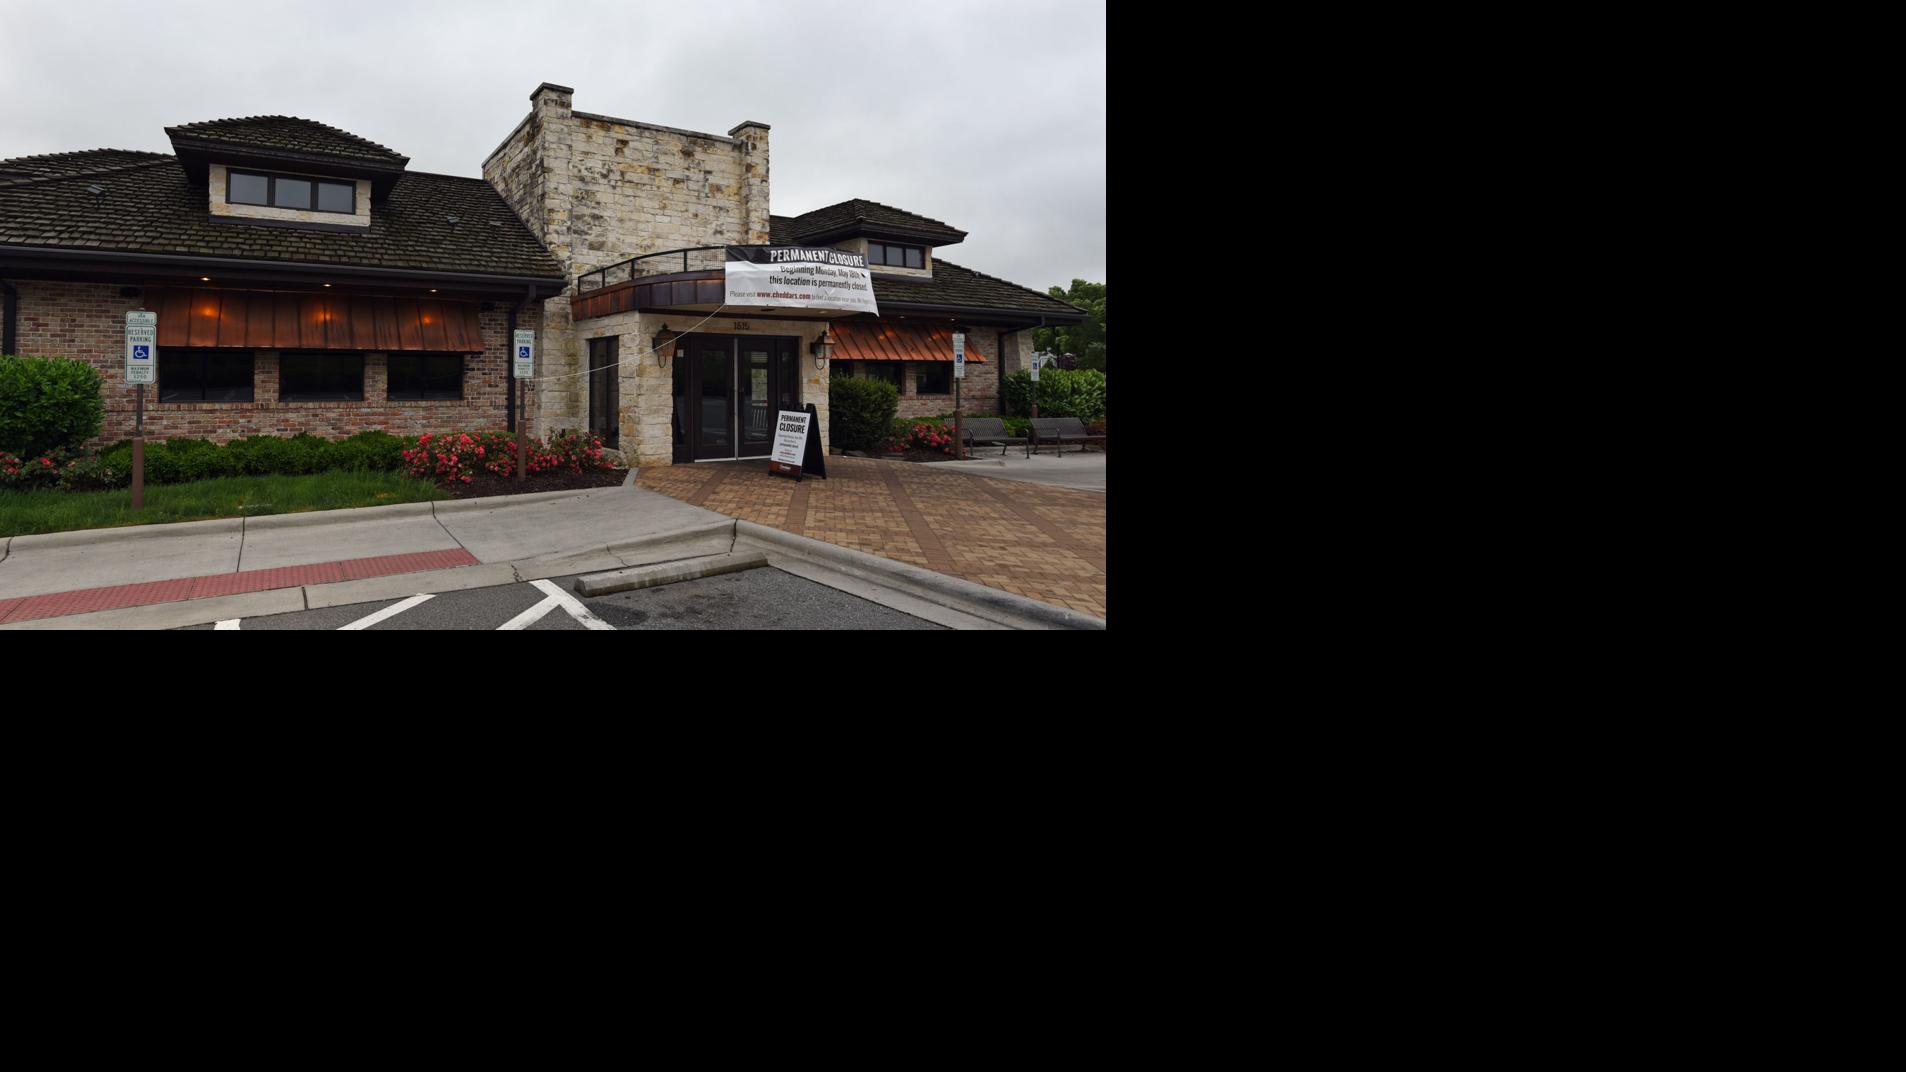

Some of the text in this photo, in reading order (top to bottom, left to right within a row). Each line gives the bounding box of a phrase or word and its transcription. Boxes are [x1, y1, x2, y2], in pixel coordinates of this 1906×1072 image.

[770, 249, 864, 267] PERMANENT CLOSURE
[780, 265, 814, 276] Beginning
[769, 275, 782, 284] this
[783, 276, 810, 286] location
[811, 277, 817, 286] is
[818, 279, 850, 290] permanently
[756, 291, 811, 300] www.cheddars.com
[781, 414, 807, 424] PERMANENT
[780, 422, 805, 434] CLOSURE
